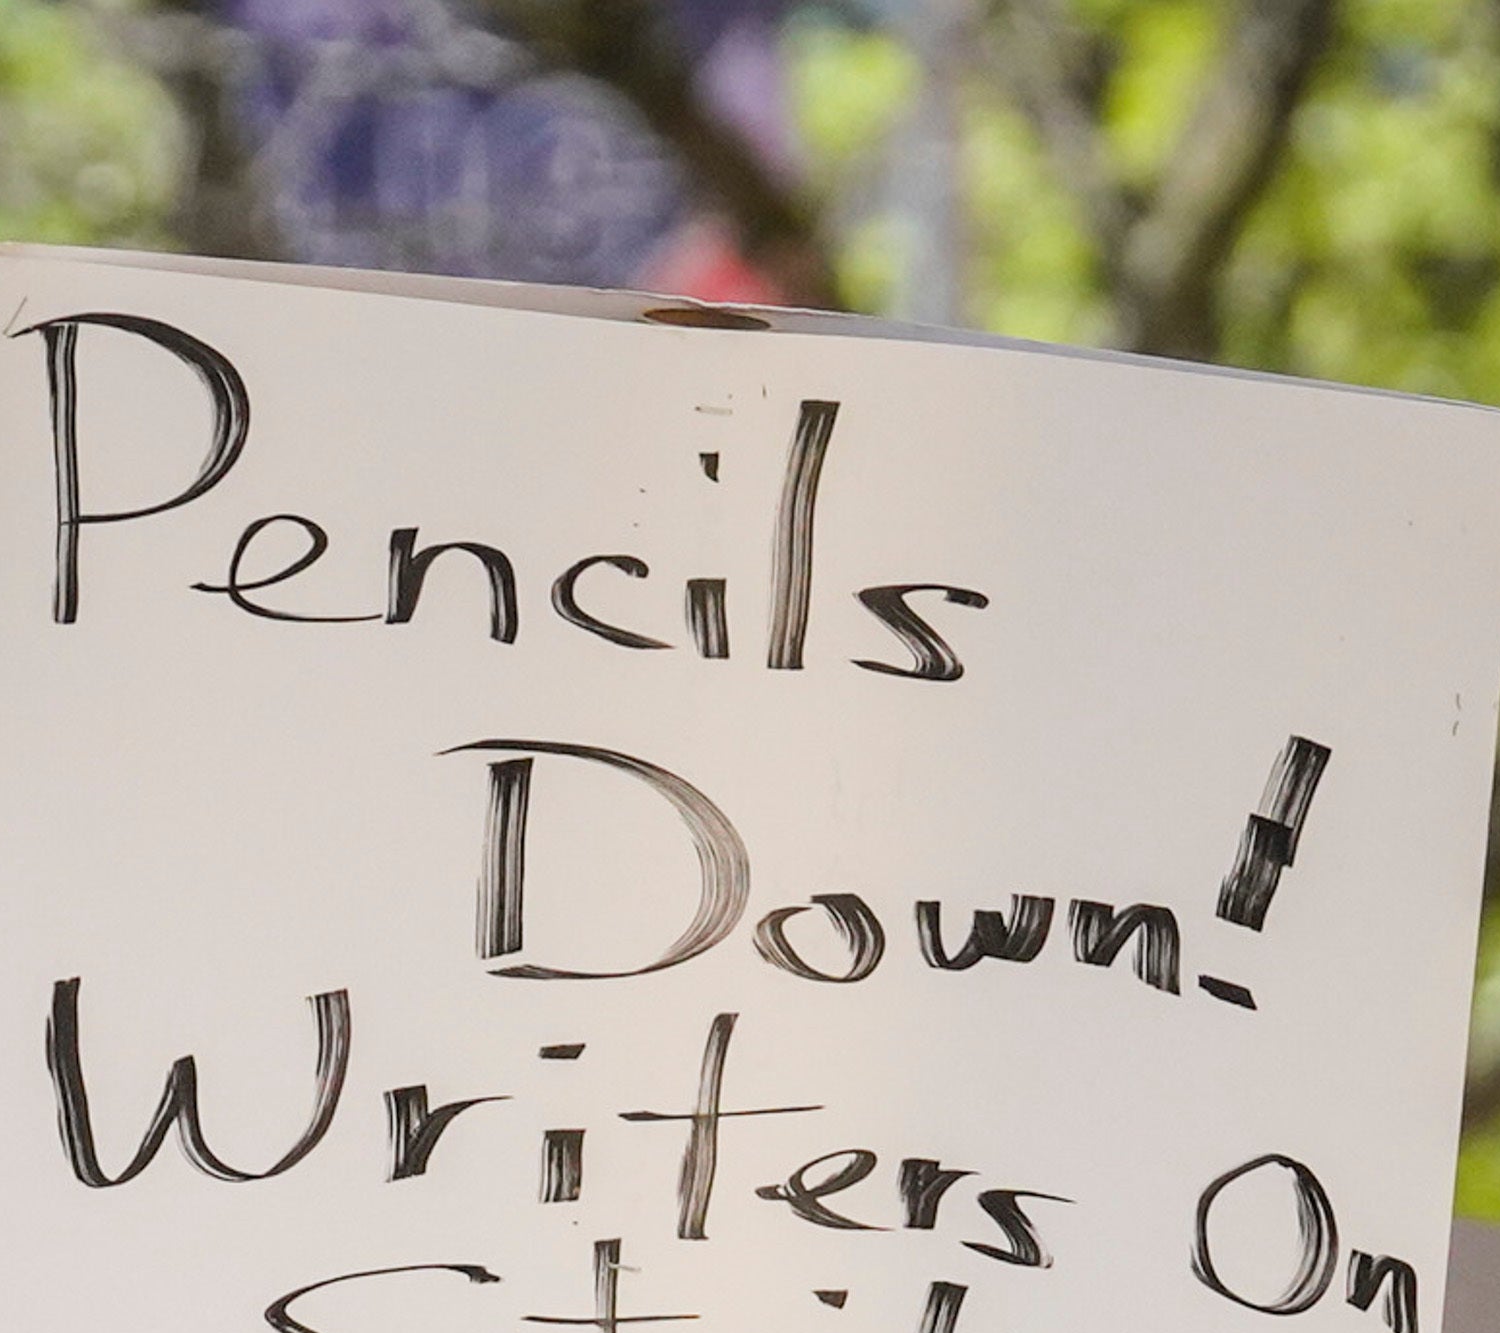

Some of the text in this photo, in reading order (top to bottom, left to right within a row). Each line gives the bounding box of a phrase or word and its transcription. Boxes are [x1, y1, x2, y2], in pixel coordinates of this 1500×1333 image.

[4, 310, 990, 681] Pencils
[436, 734, 1333, 1012] Down!
[43, 976, 1077, 1272] Writers
